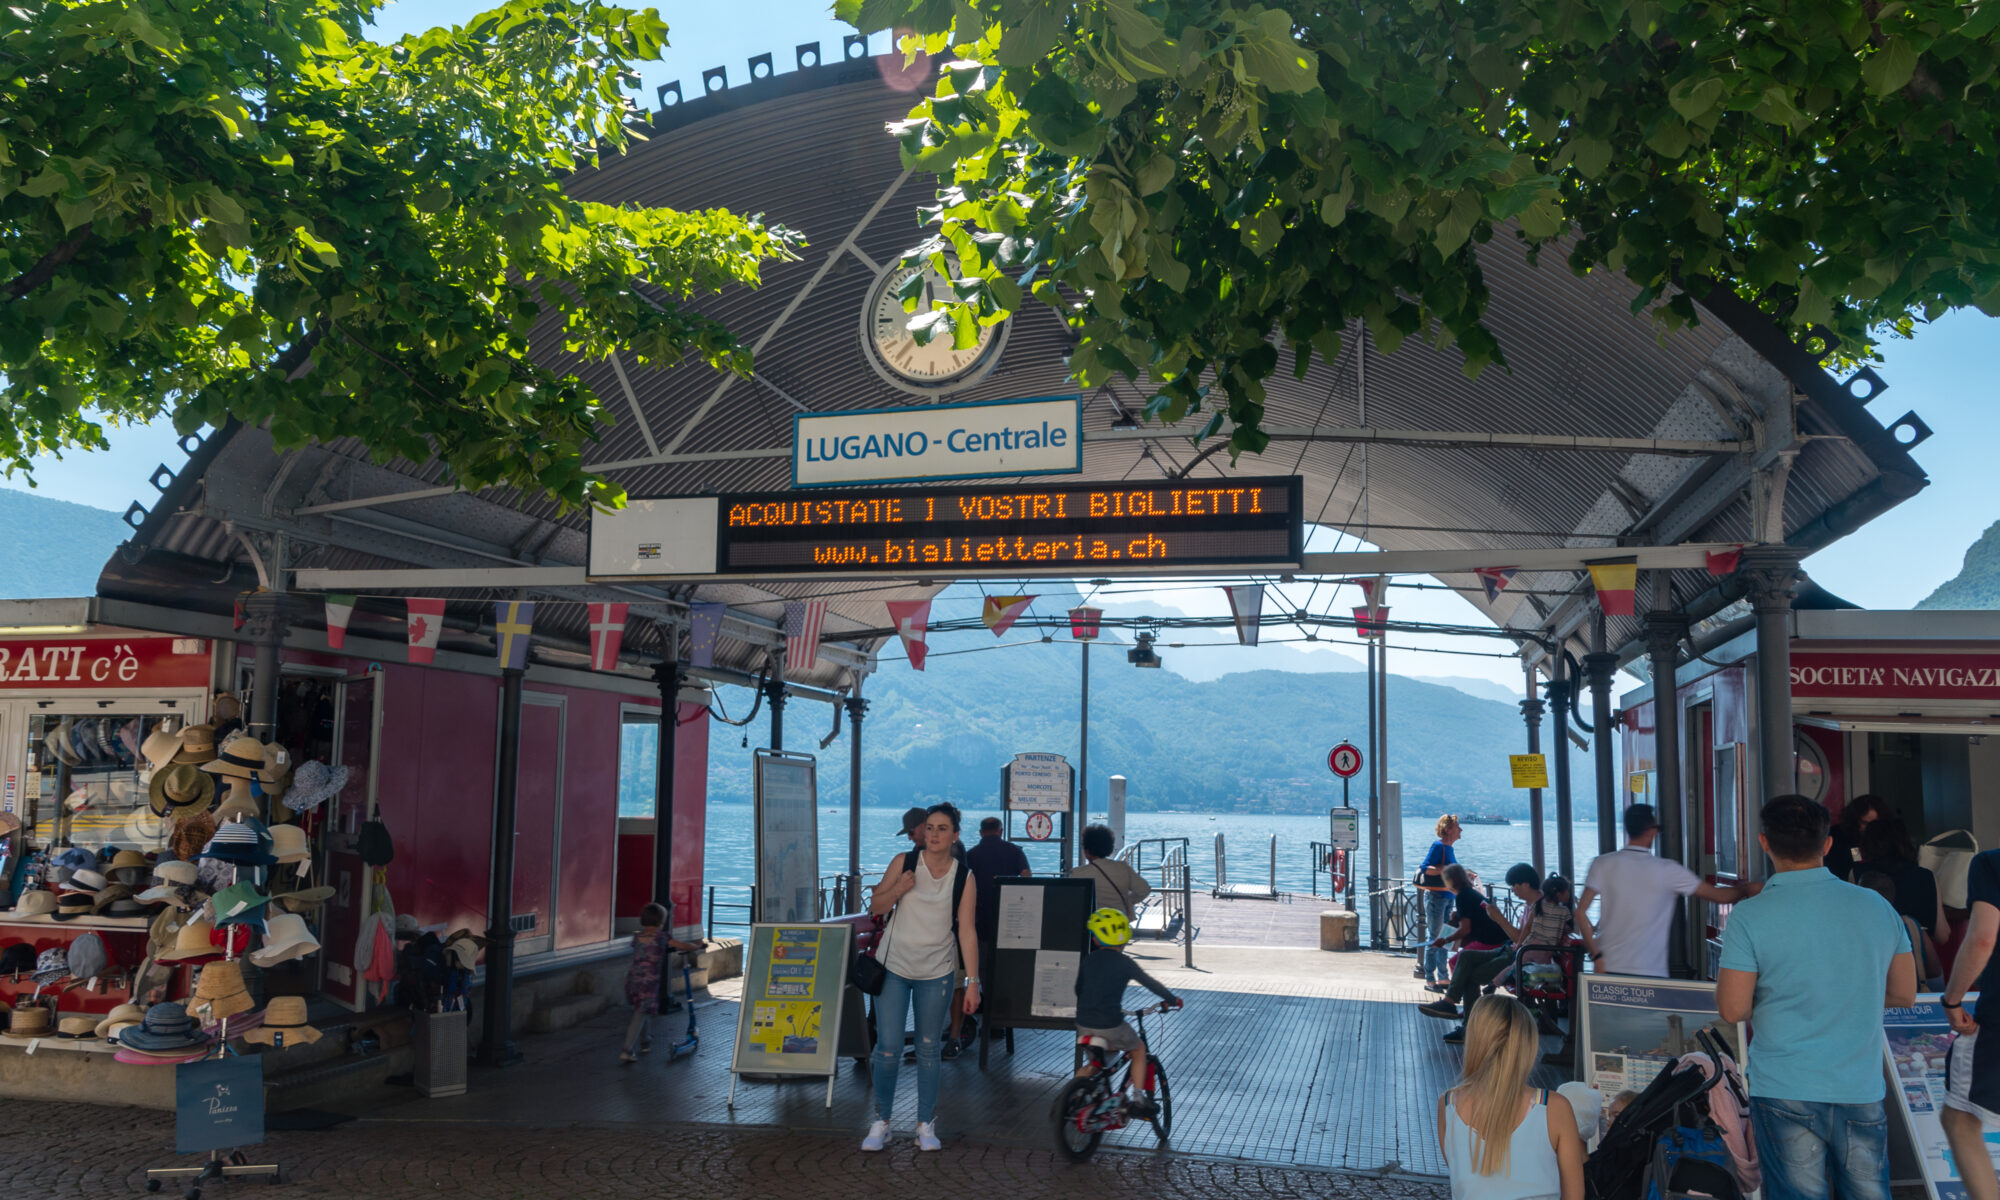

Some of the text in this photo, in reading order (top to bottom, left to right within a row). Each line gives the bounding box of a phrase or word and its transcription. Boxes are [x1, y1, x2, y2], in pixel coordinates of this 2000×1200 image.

[806, 431, 928, 462] LUGANO
[947, 421, 1067, 453] Centrale
[729, 498, 903, 527] ACQUISTATE
[959, 493, 1067, 520] VOSTRI
[1090, 488, 1262, 517] BIGLIETTI
[1592, 985, 1655, 998] CLASSIC TOUR
